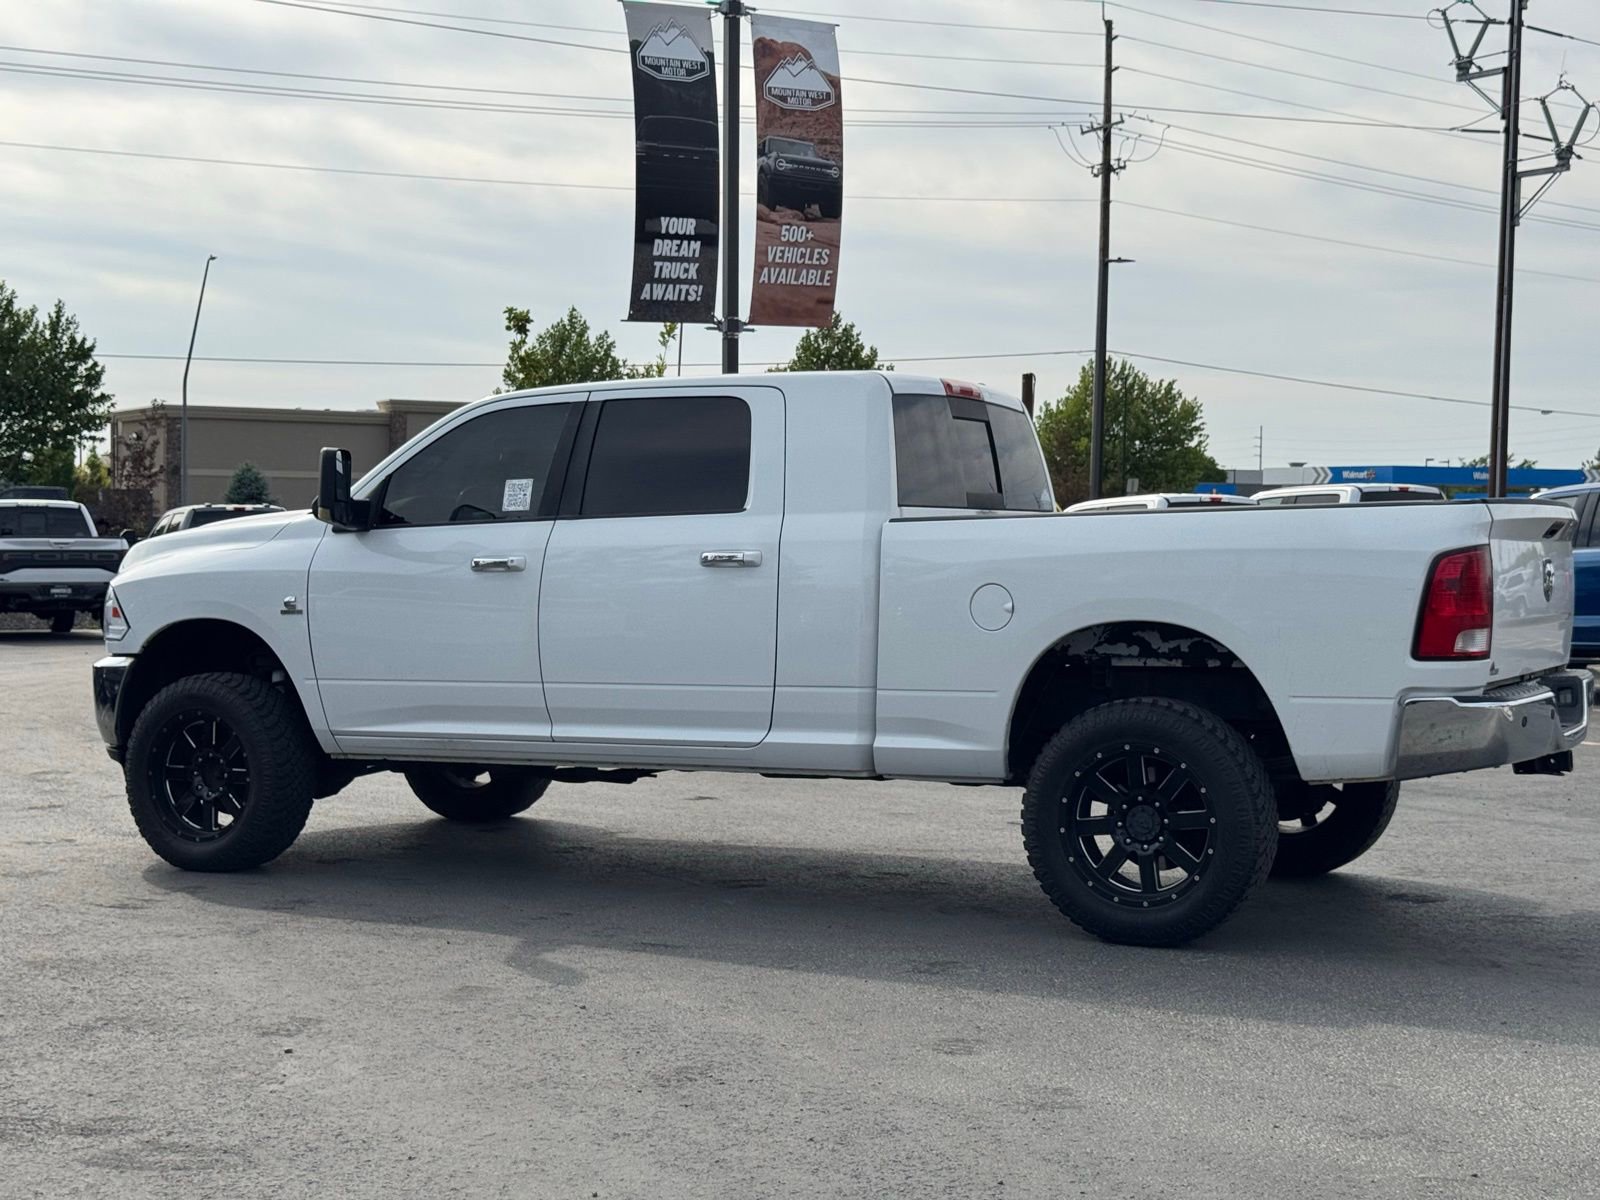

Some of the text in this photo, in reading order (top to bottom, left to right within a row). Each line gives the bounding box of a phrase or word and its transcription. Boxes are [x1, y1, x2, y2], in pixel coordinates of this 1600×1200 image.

[644, 56, 701, 70] MOUNTAIN WEST
[661, 66, 687, 77] MOTOR
[771, 87, 827, 100] MOUNTAIN WEST
[787, 97, 812, 106] MOTOR
[660, 216, 697, 236] YOUR
[780, 225, 815, 243] 500+
[652, 239, 701, 258] DREAM
[767, 246, 831, 266] VEHICLES
[653, 261, 700, 280] TRUCK
[758, 267, 834, 287] AVAILABLE
[640, 284, 704, 302] AWAITS!
[1342, 470, 1368, 479] Walmart
